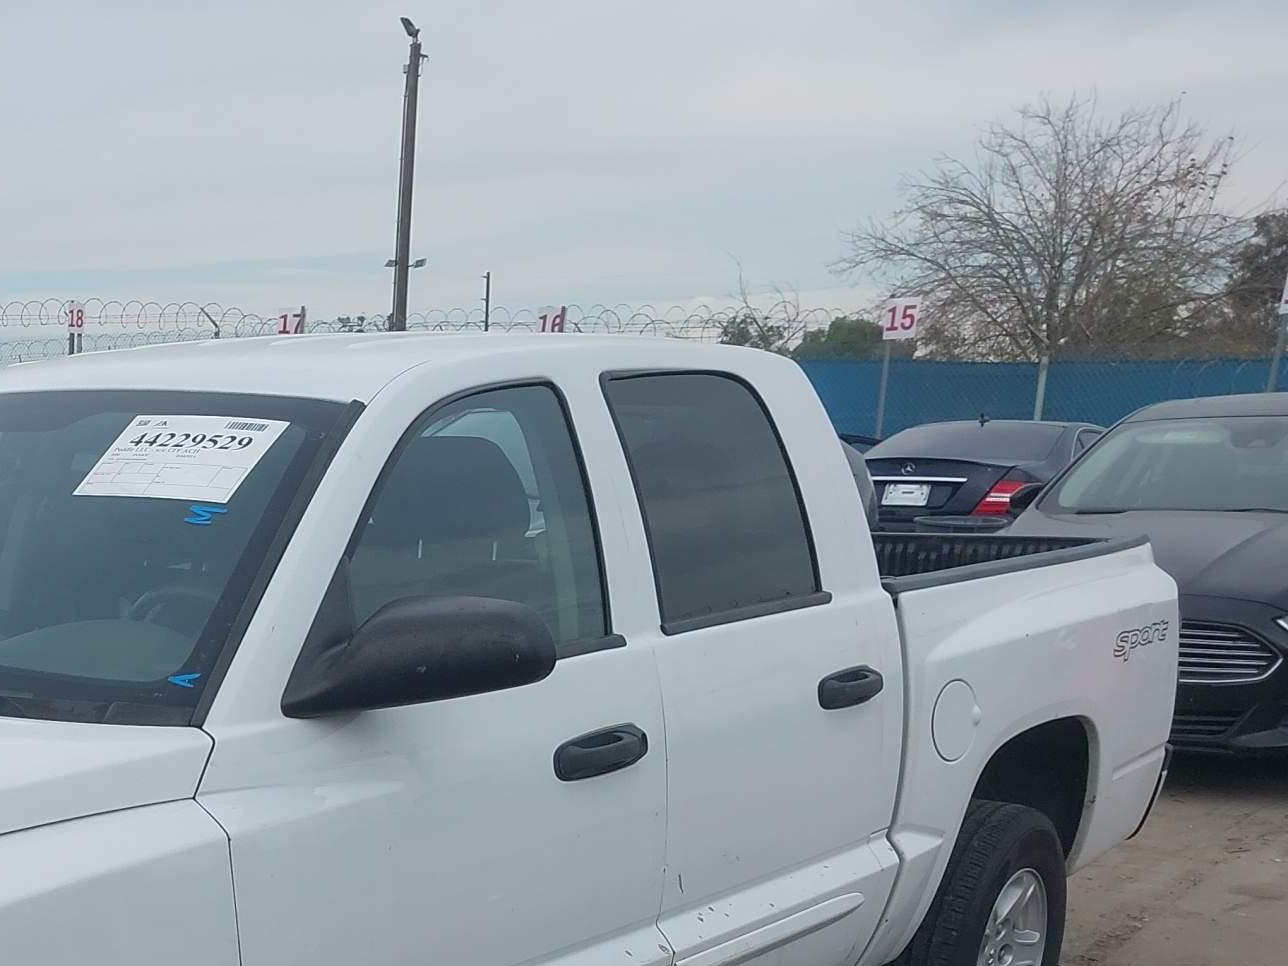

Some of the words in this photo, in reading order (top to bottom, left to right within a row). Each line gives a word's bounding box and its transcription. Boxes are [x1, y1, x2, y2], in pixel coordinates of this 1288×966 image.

[68, 309, 83, 328] 18
[278, 313, 305, 334] 17
[886, 304, 918, 331] 15
[129, 432, 254, 450] 44229529
